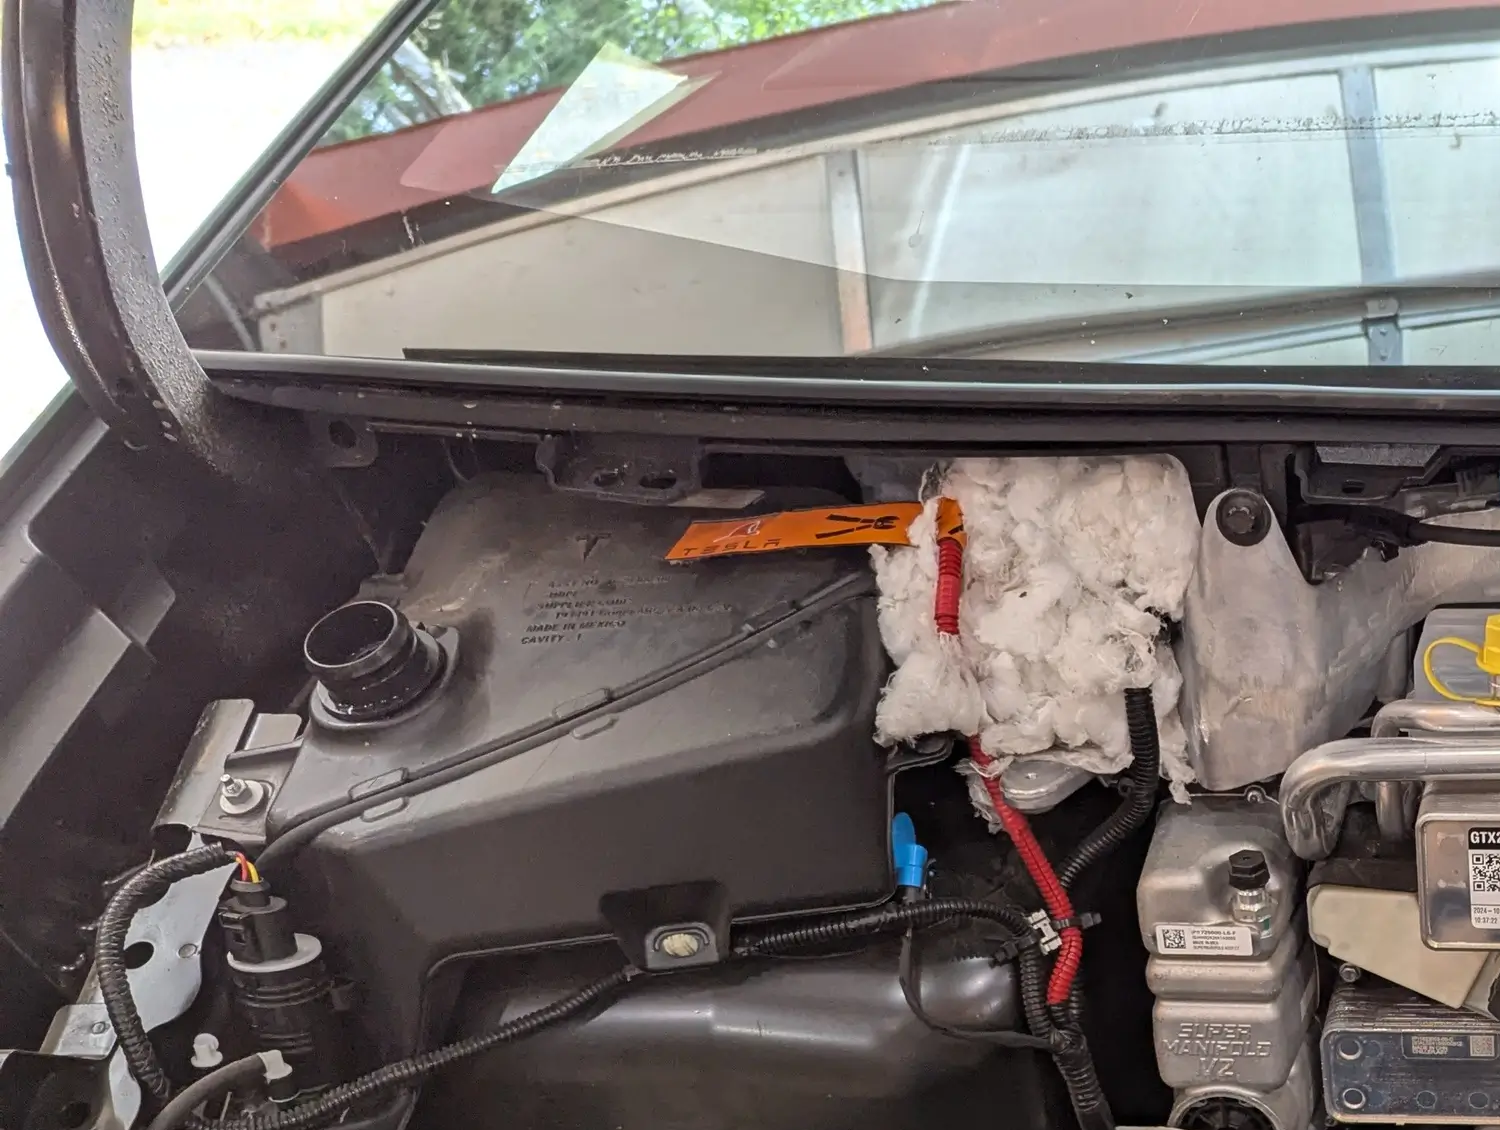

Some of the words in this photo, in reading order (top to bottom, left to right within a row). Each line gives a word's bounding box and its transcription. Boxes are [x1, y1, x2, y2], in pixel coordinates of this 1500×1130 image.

[683, 539, 783, 556] TESLA
[526, 623, 559, 633] MADE
[563, 622, 576, 631] IN
[580, 621, 626, 630] MEXICO
[1177, 1022, 1252, 1038] SUPER
[1162, 1039, 1272, 1056] MANIFOLD
